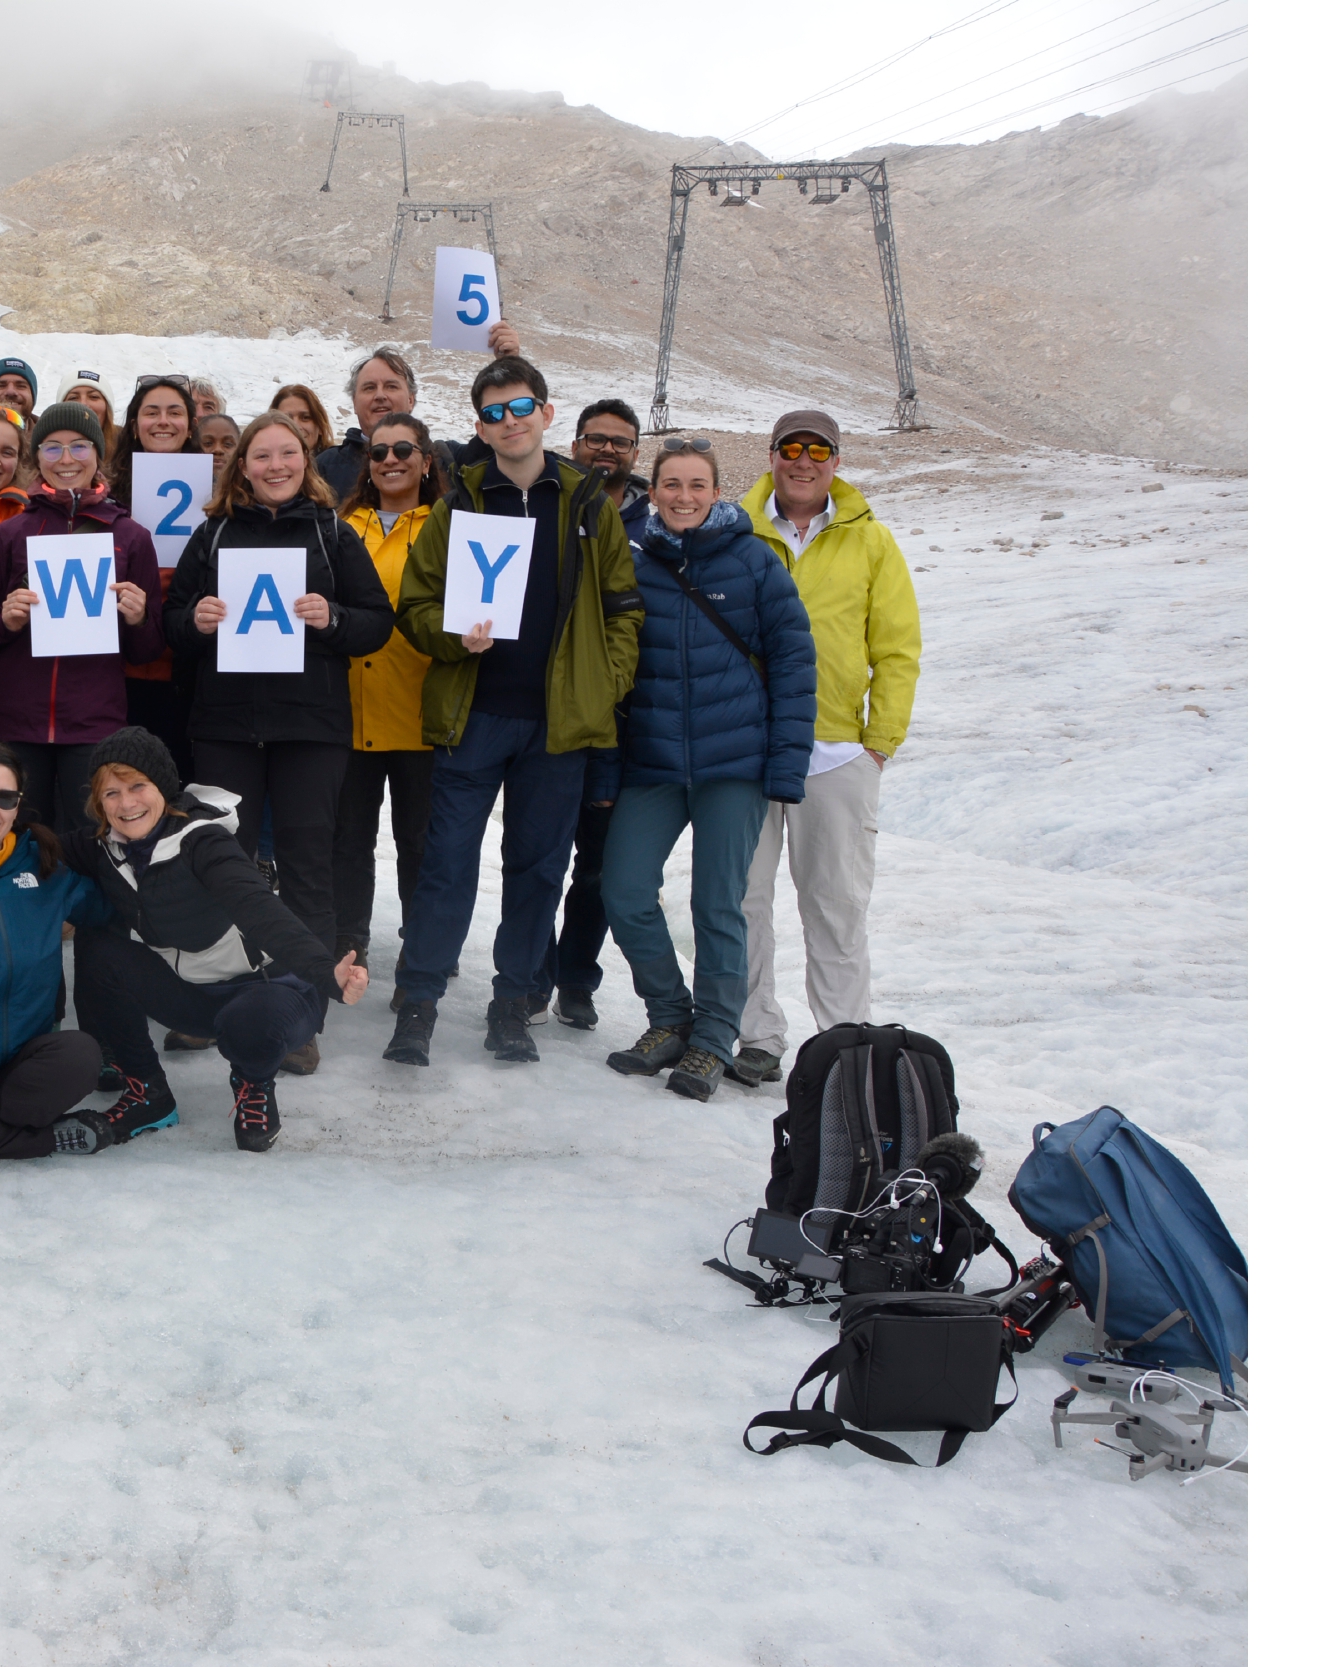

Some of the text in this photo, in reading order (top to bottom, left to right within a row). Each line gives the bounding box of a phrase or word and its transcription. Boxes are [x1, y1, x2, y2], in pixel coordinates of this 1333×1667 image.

[456, 273, 490, 326] 5
[155, 479, 193, 536] 2
[35, 557, 112, 619] W
[467, 540, 520, 604] Y
[235, 573, 295, 635] A
